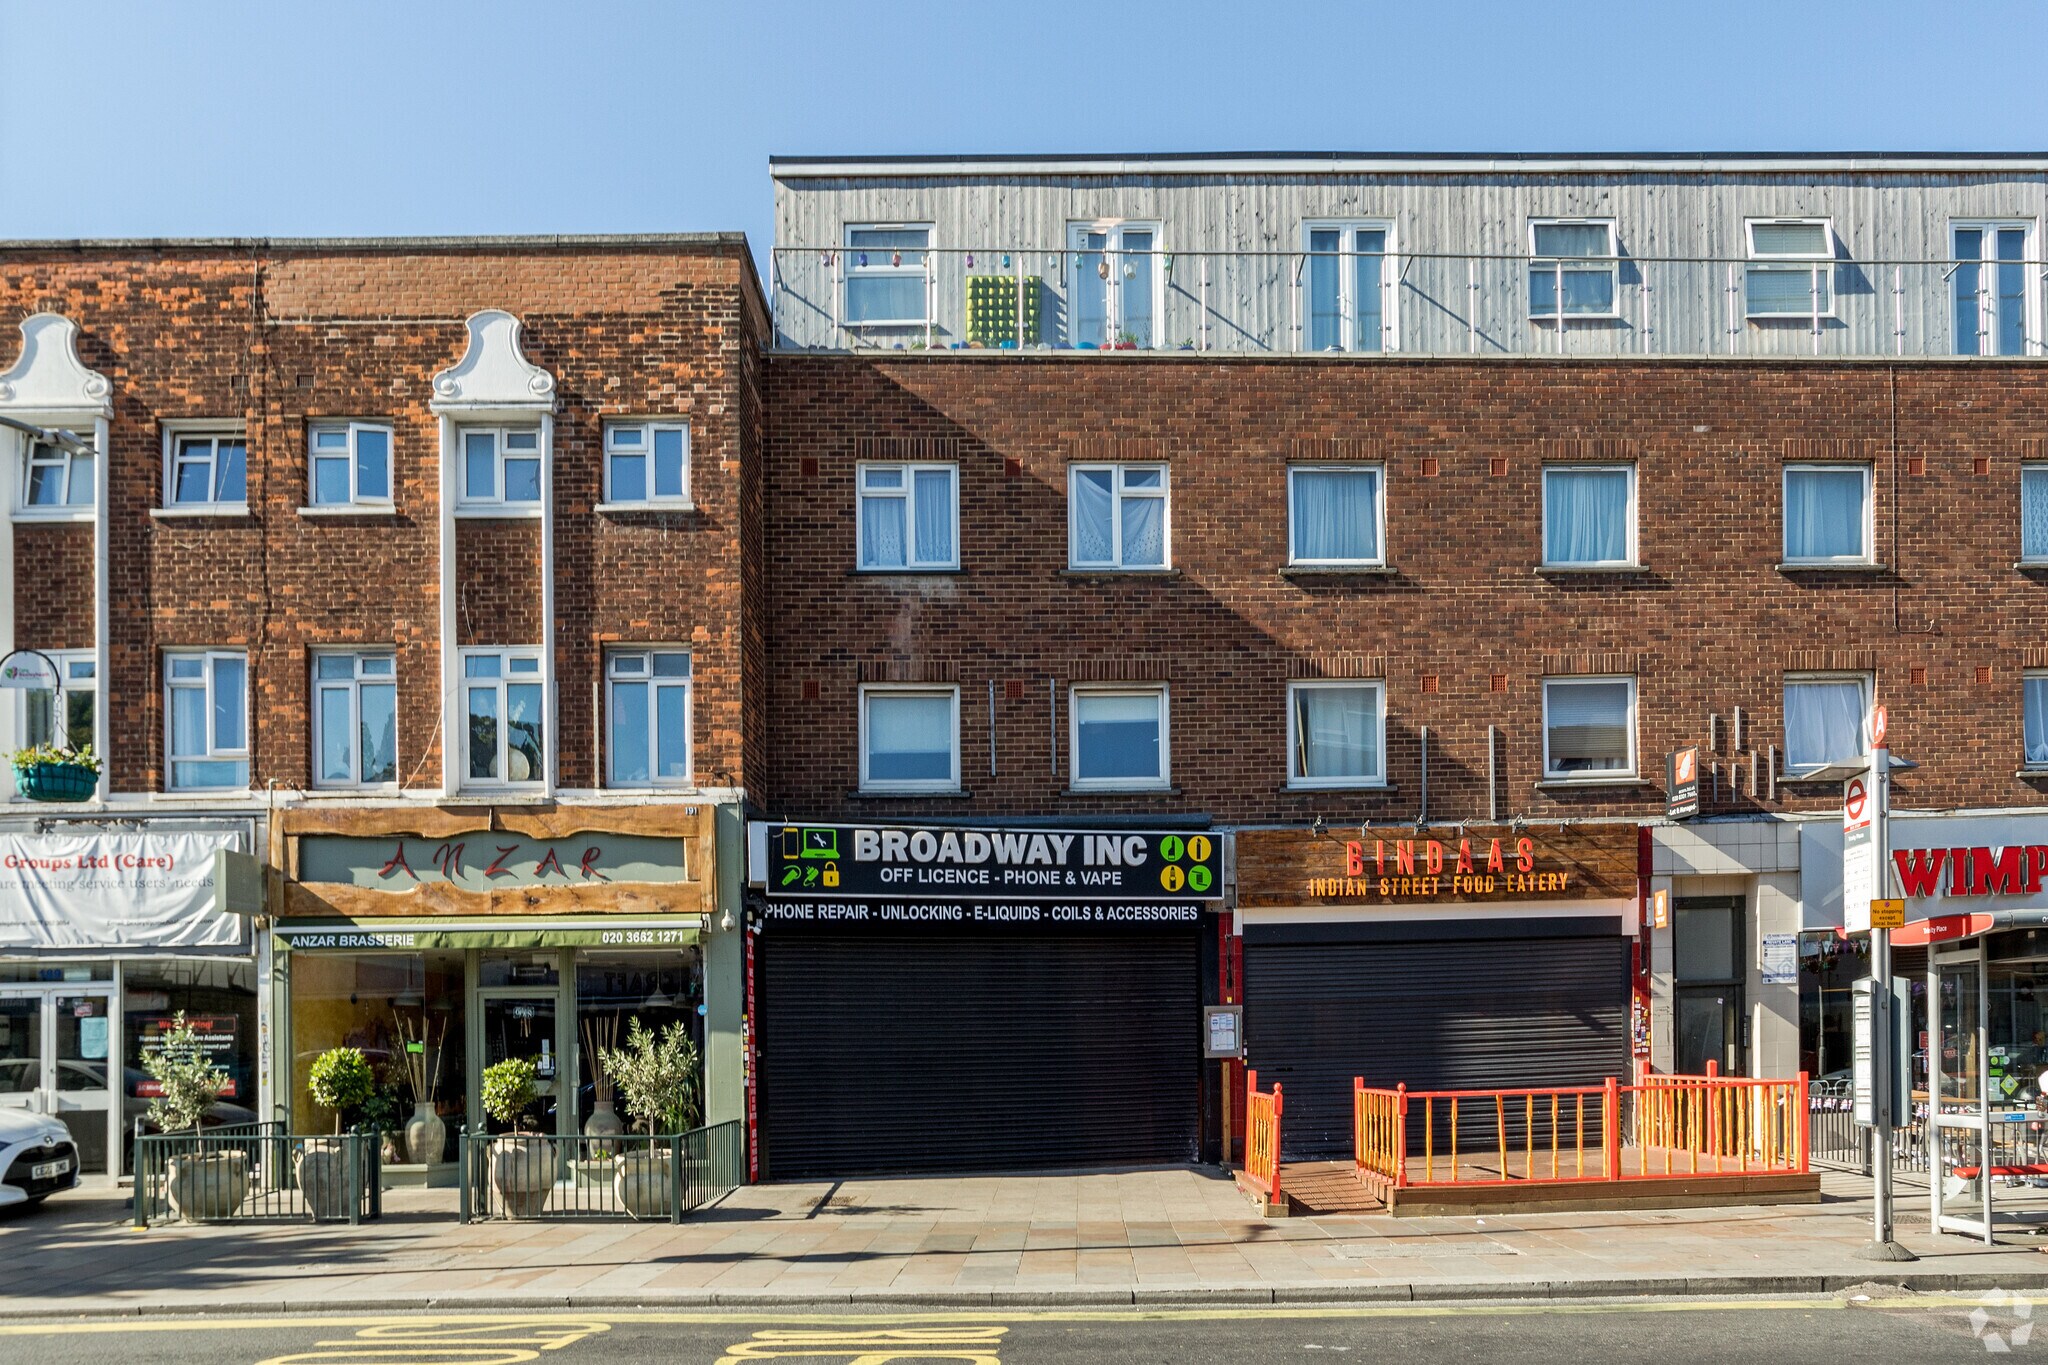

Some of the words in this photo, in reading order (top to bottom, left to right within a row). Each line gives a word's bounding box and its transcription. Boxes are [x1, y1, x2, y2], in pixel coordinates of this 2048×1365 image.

[1875, 711, 1885, 737] A
[685, 806, 699, 816] 191
[855, 830, 1075, 865] BROADWAY
[1083, 835, 1148, 866] INC
[4, 854, 71, 872] Groups
[77, 854, 109, 869] Ltd
[114, 853, 174, 872] (Care)
[378, 840, 608, 880] ANZAR
[1347, 837, 1533, 877] BINDAAS
[22, 878, 75, 892] meeting
[79, 877, 125, 890] service
[175, 875, 214, 888] needs
[880, 868, 913, 883] OFF
[918, 868, 989, 884] LICENCE
[1004, 870, 1060, 885] PHONE
[1065, 870, 1076, 885] &
[1080, 871, 1122, 885] VAPE
[1310, 877, 1367, 897] INDIAN
[1380, 876, 1440, 896] STREET
[1453, 875, 1494, 894] FOOD
[1507, 872, 1568, 892] EATERY
[765, 904, 813, 919] PHONE
[818, 904, 869, 919] REPAIR
[881, 905, 962, 920] UNLOCKING
[974, 905, 1040, 921] E-LIQUIDS
[1052, 905, 1091, 920] COILS
[1094, 905, 1104, 920] &
[1107, 905, 1198, 920] ACCESSORIES
[1881, 908, 1903, 916] stopping
[1936, 925, 1948, 933] Place
[291, 934, 335, 947] ANZAR
[339, 933, 415, 946] BRASSERIE
[602, 931, 623, 943] 020
[626, 931, 654, 943] 3662
[657, 930, 684, 942] 1271
[204, 1034, 234, 1042] Assistants
